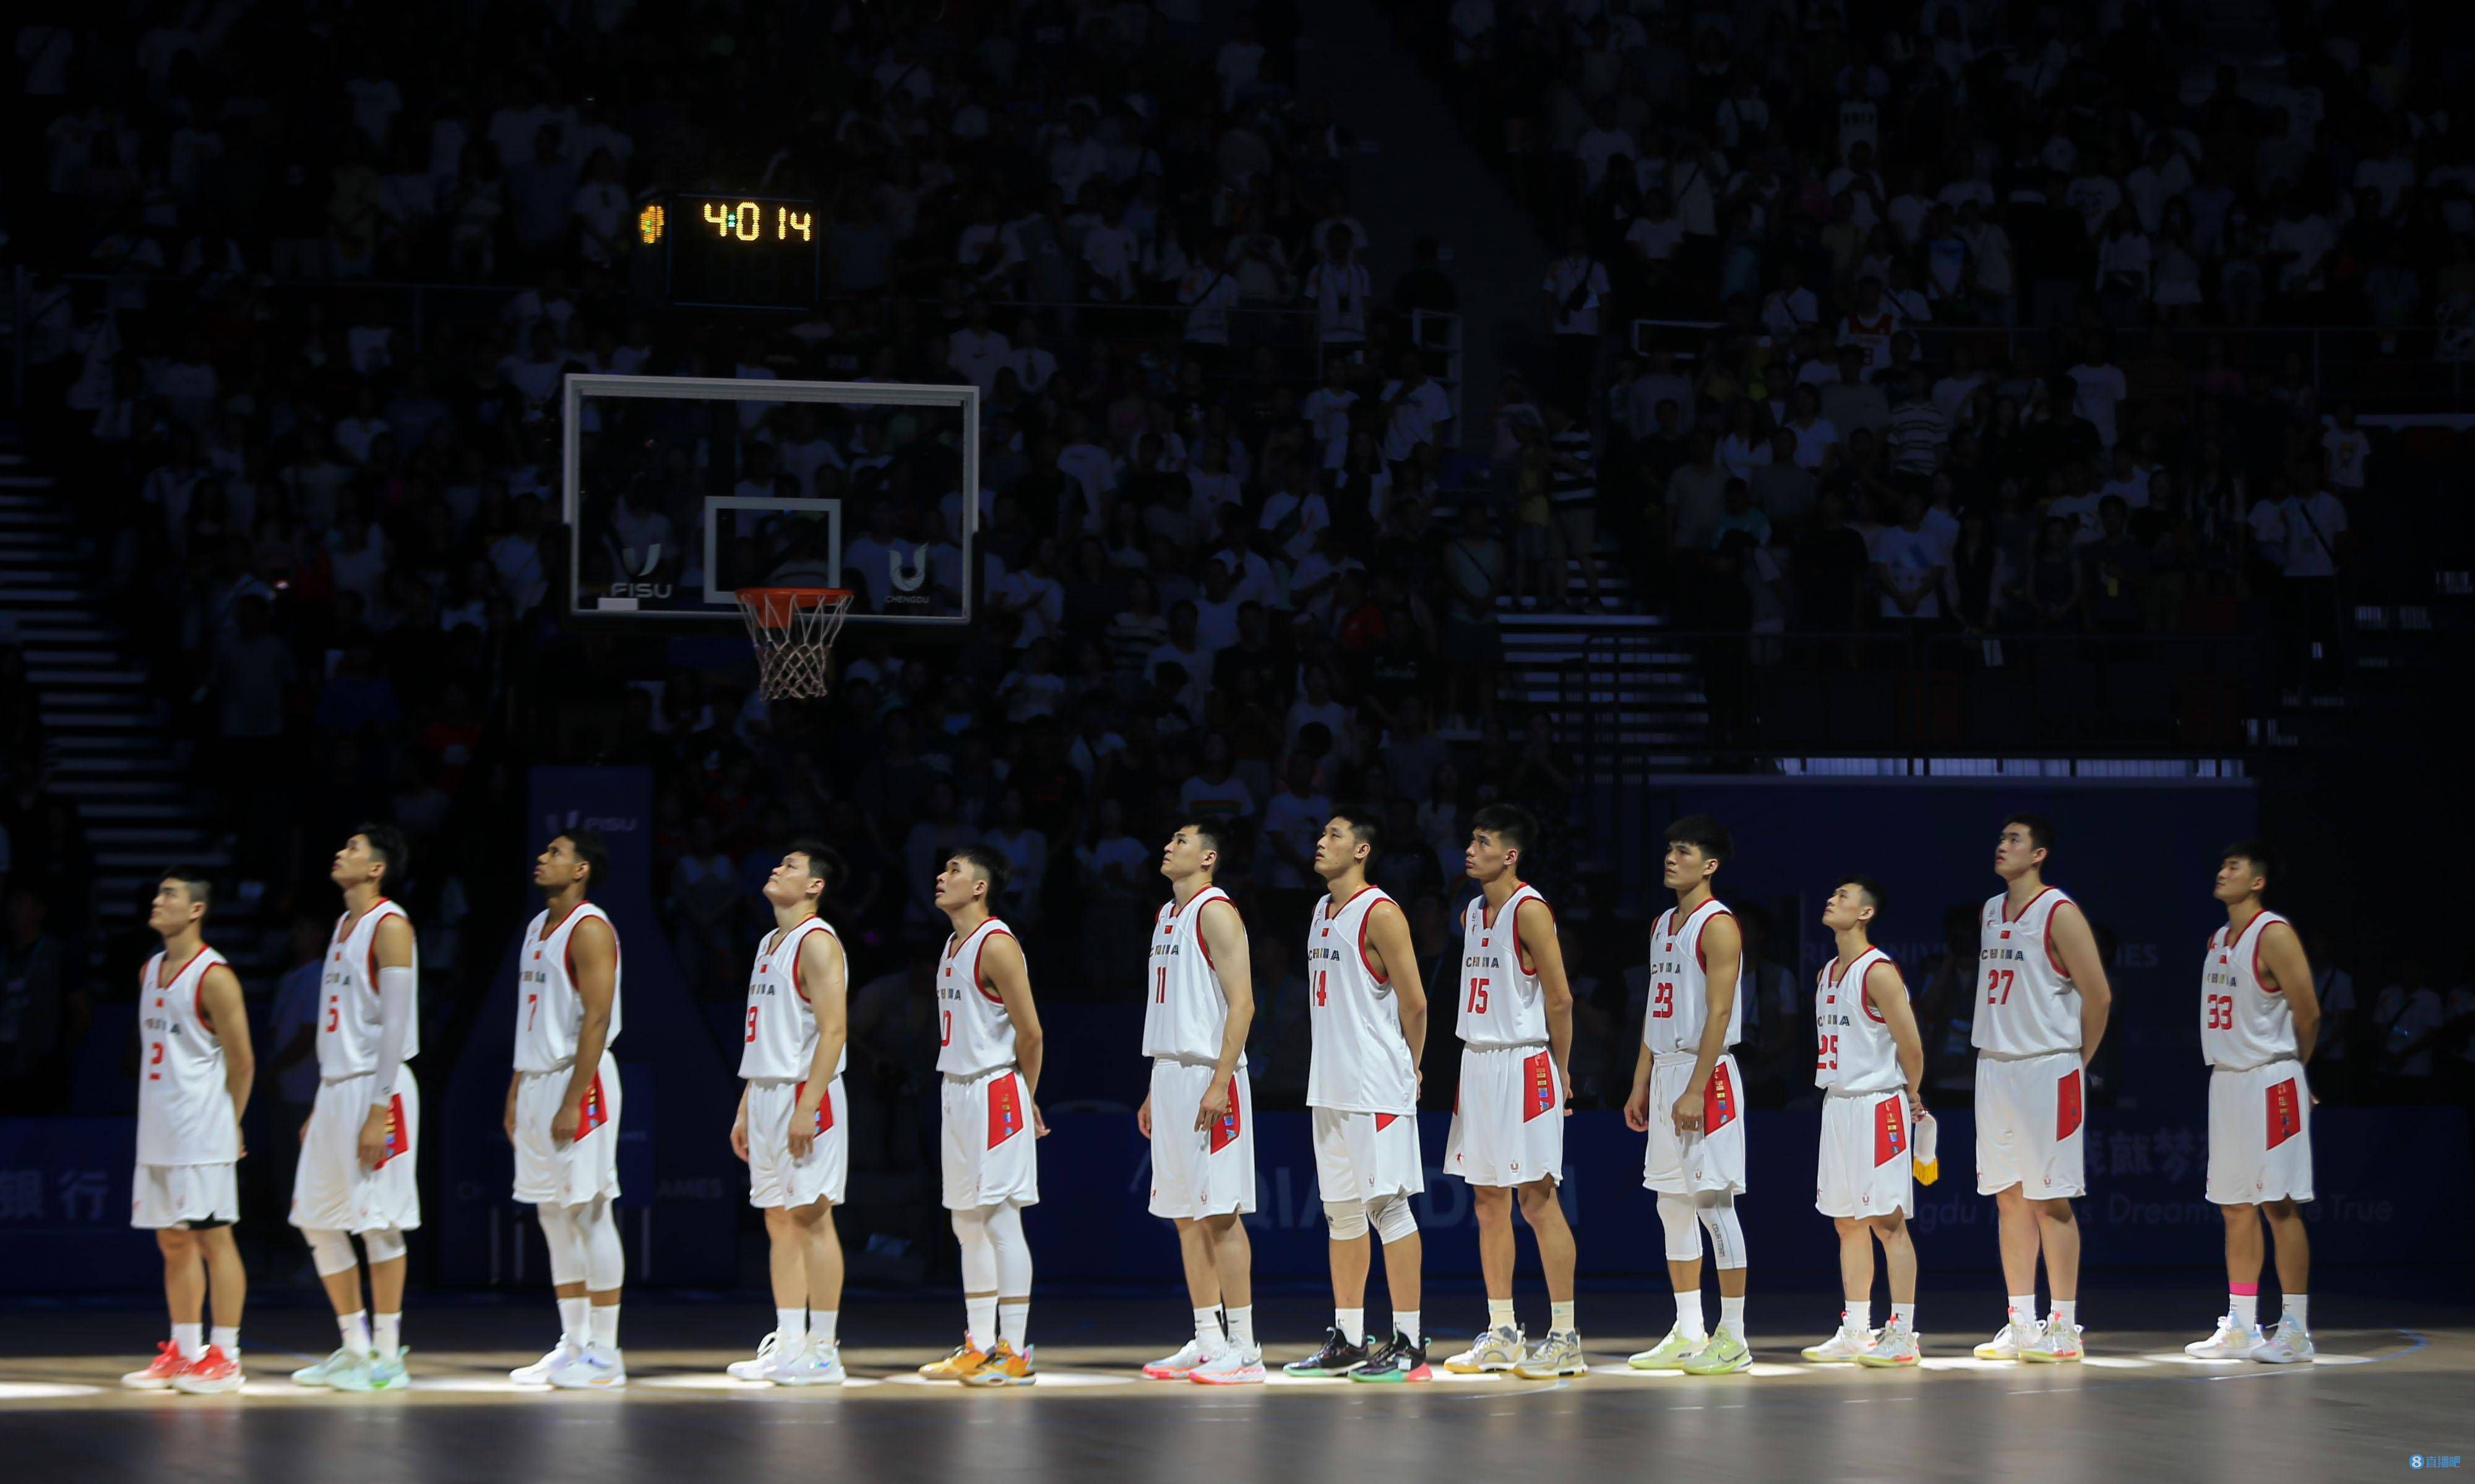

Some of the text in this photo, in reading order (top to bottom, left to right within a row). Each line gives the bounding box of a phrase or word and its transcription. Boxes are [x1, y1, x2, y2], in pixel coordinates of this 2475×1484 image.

[610, 582, 673, 599] FISU
[1309, 947, 1340, 962] CHINA
[1466, 956, 1499, 969] CHINA
[1981, 948, 2024, 961] CHINA
[1156, 967, 1166, 1003] 11
[1312, 970, 1327, 1007] 14
[1467, 977, 1490, 1014] 15
[1653, 982, 1674, 1019] 23
[1987, 969, 2015, 1005] 27
[528, 994, 538, 1032] 7
[2207, 994, 2232, 1031] 33
[1817, 1034, 1838, 1070] 25
